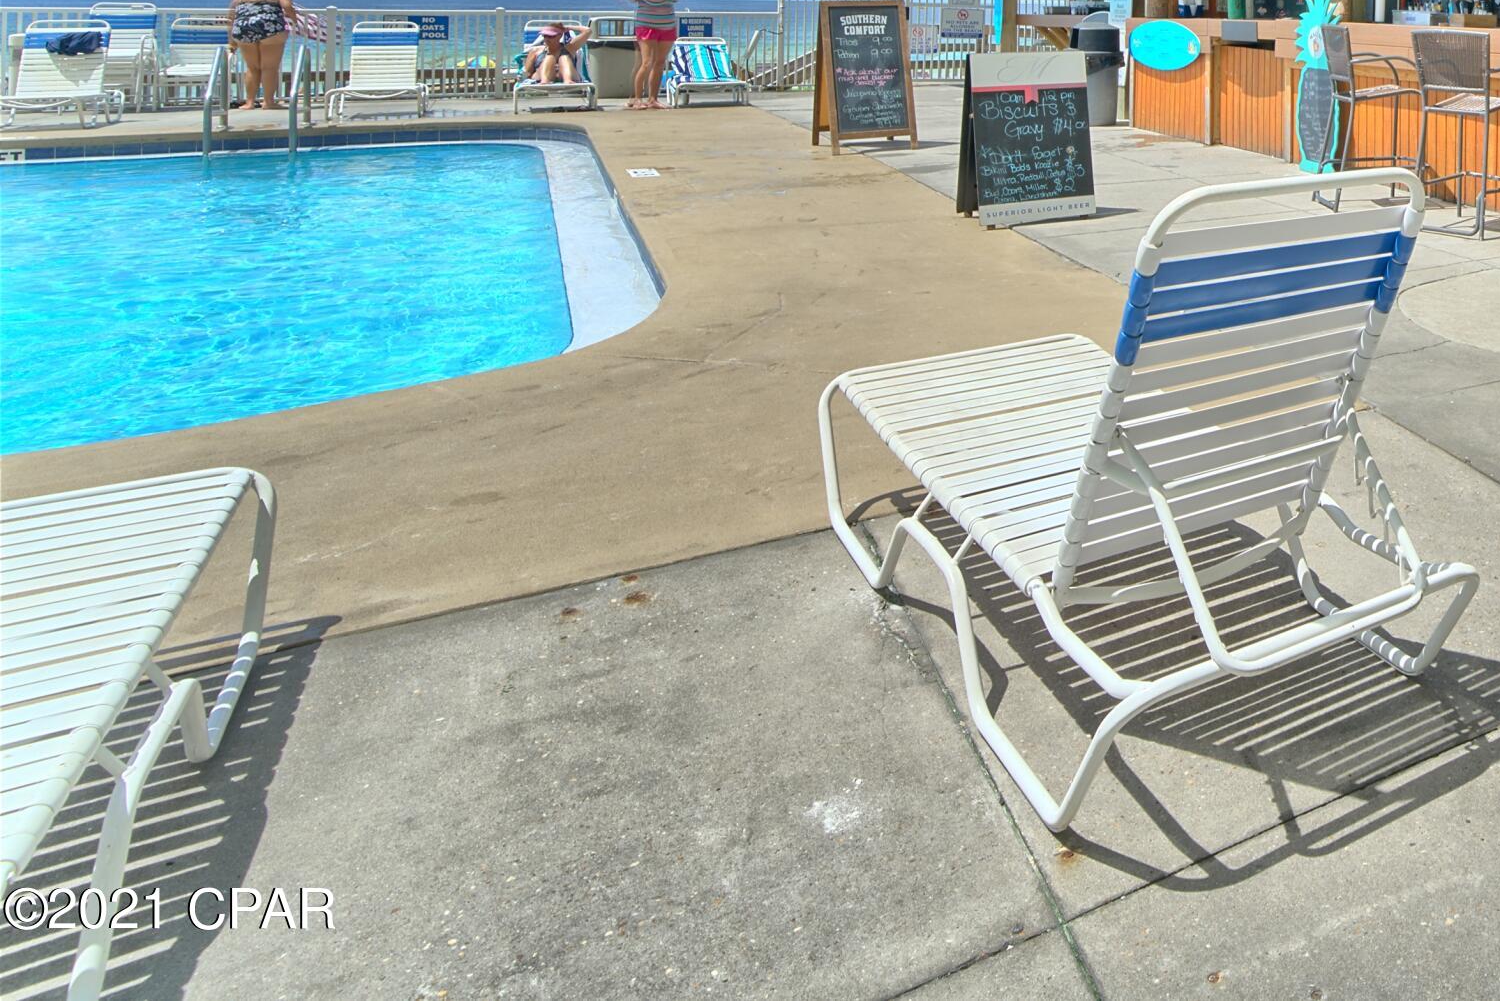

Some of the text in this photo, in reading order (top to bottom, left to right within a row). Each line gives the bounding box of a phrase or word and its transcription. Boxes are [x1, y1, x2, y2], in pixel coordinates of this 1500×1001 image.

[840, 15, 887, 26] SOUTHERN
[844, 25, 885, 35] COMFORT
[1060, 91, 1075, 103] pm
[978, 97, 1059, 119] Biscuits
[1004, 120, 1044, 142] Gravy
[1054, 178, 1076, 193] $2
[986, 202, 1090, 218] SUPERIOR LIGHT BEER
